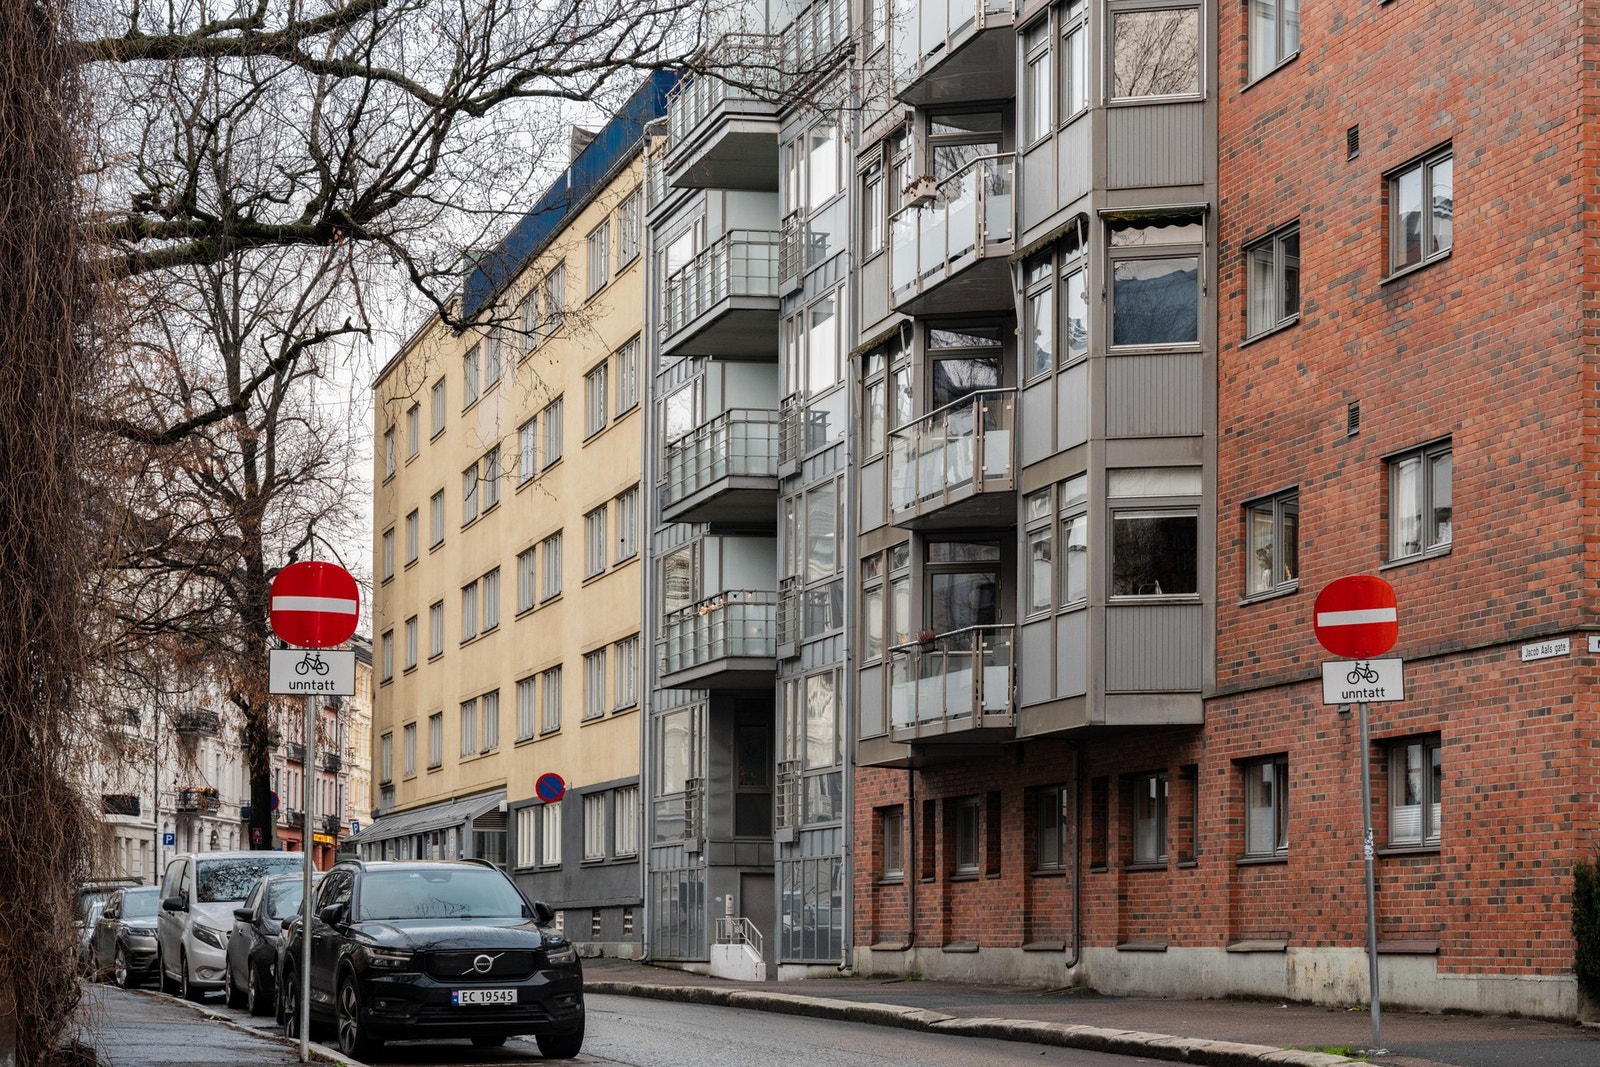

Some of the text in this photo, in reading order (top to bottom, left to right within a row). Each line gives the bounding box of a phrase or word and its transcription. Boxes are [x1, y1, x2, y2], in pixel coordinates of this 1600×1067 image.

[1525, 646, 1539, 657] Jacob
[1555, 643, 1566, 654] gate
[289, 680, 335, 690] unntatt
[1341, 687, 1385, 699] unntatt
[165, 835, 173, 844] P
[462, 991, 513, 1002] EC 19545
